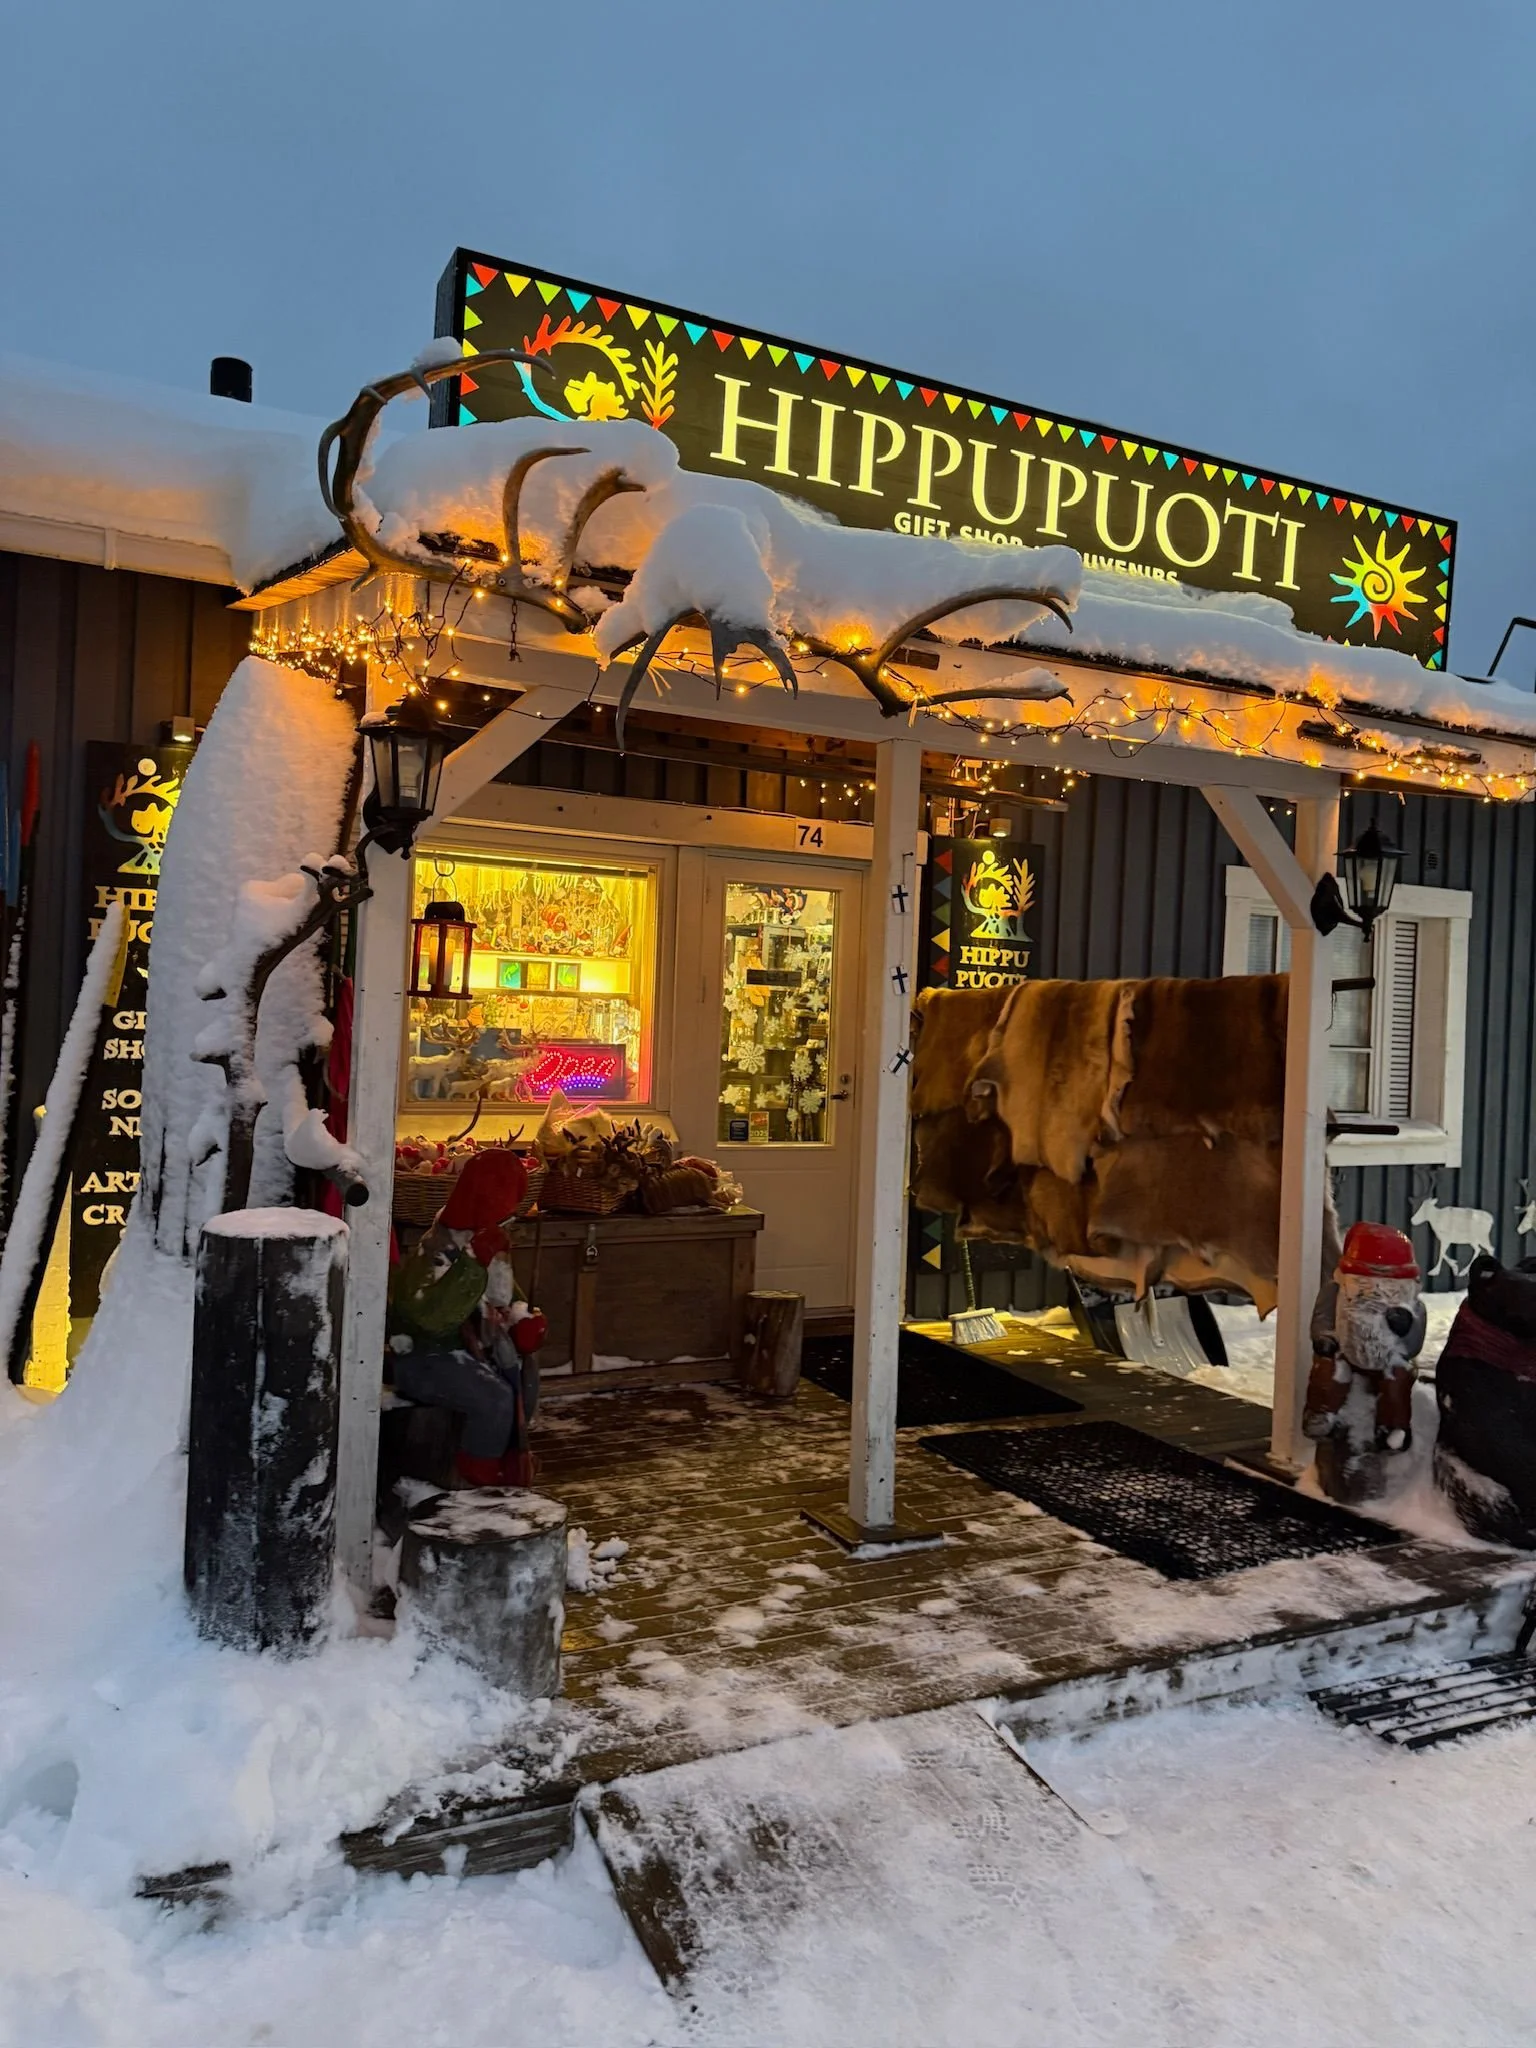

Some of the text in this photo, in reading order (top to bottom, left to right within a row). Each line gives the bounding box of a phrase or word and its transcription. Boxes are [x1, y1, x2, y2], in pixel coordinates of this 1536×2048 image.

[710, 374, 1305, 591] HIPPUPUOTI
[893, 512, 951, 541] GIFT
[1083, 552, 1180, 585] UVENIRS
[798, 825, 823, 848] 74
[94, 886, 158, 911] HIP
[959, 945, 1030, 969] HIPPU
[112, 1010, 148, 1030] GI
[103, 1038, 146, 1060] SH
[531, 1051, 616, 1095] Open
[101, 1088, 142, 1110] SO
[109, 1115, 143, 1139] NI
[82, 1204, 127, 1226] CR
